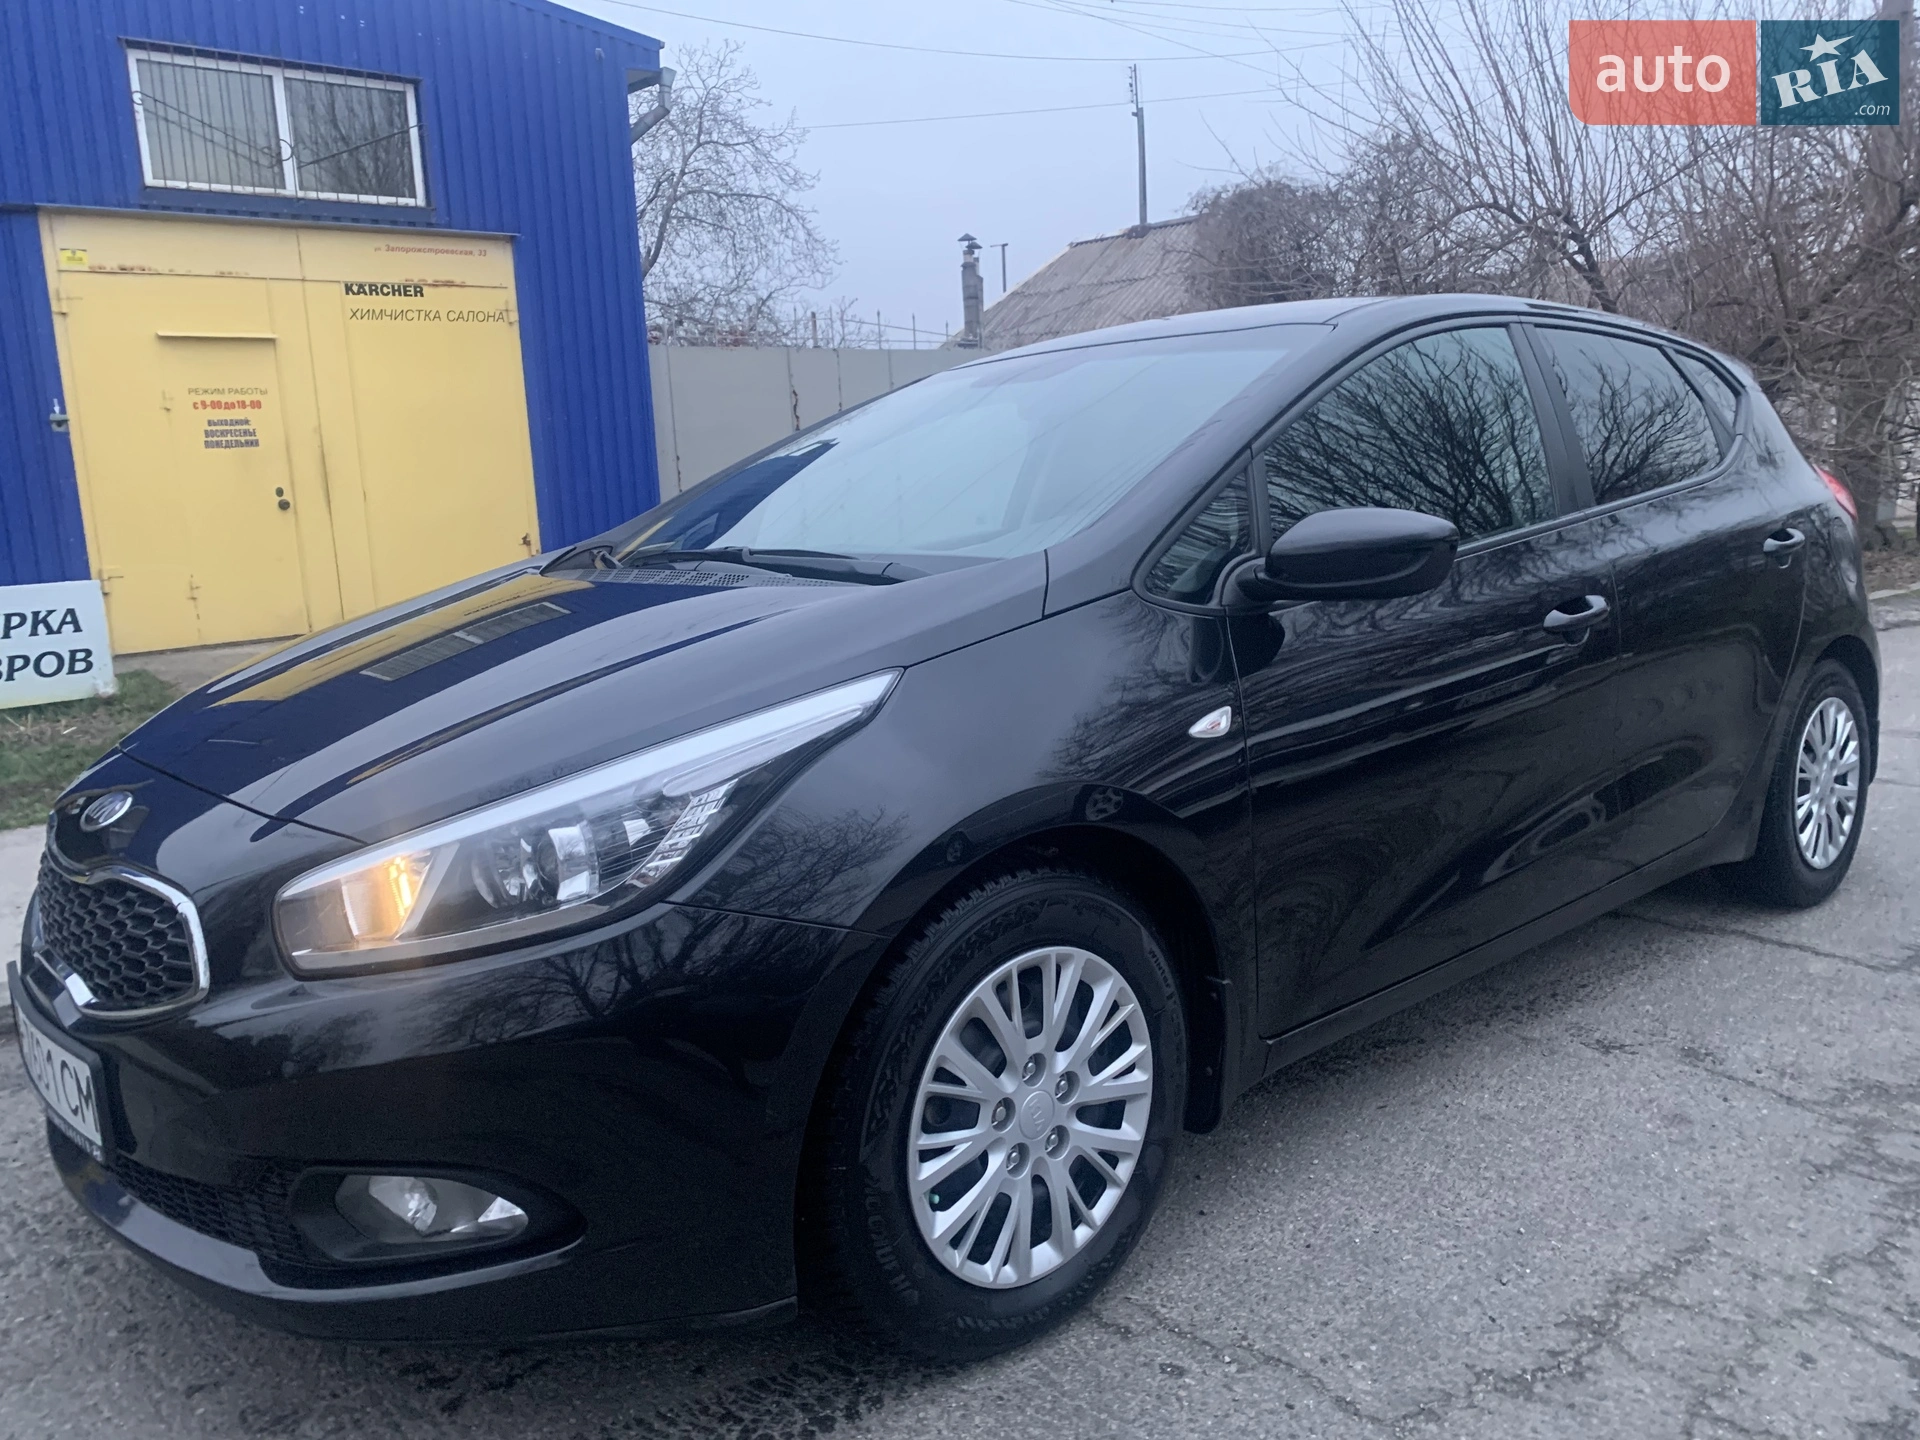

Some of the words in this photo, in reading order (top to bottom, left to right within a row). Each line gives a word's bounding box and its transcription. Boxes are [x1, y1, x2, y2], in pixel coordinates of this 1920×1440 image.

[477, 249, 487, 257] 33
[349, 308, 442, 322] ХИМЧИСТКА
[446, 309, 505, 323] САЛОНА
[187, 387, 226, 396] РЕЖИМ
[227, 387, 268, 396] РАБОТЫ
[200, 399, 223, 410] 9-00
[223, 401, 236, 411] до
[236, 399, 262, 410] 18-00
[203, 428, 257, 439] ВОСКРЕСЕНЬЕ
[0, 608, 83, 640] РКА
[0, 648, 94, 682] РОВ
